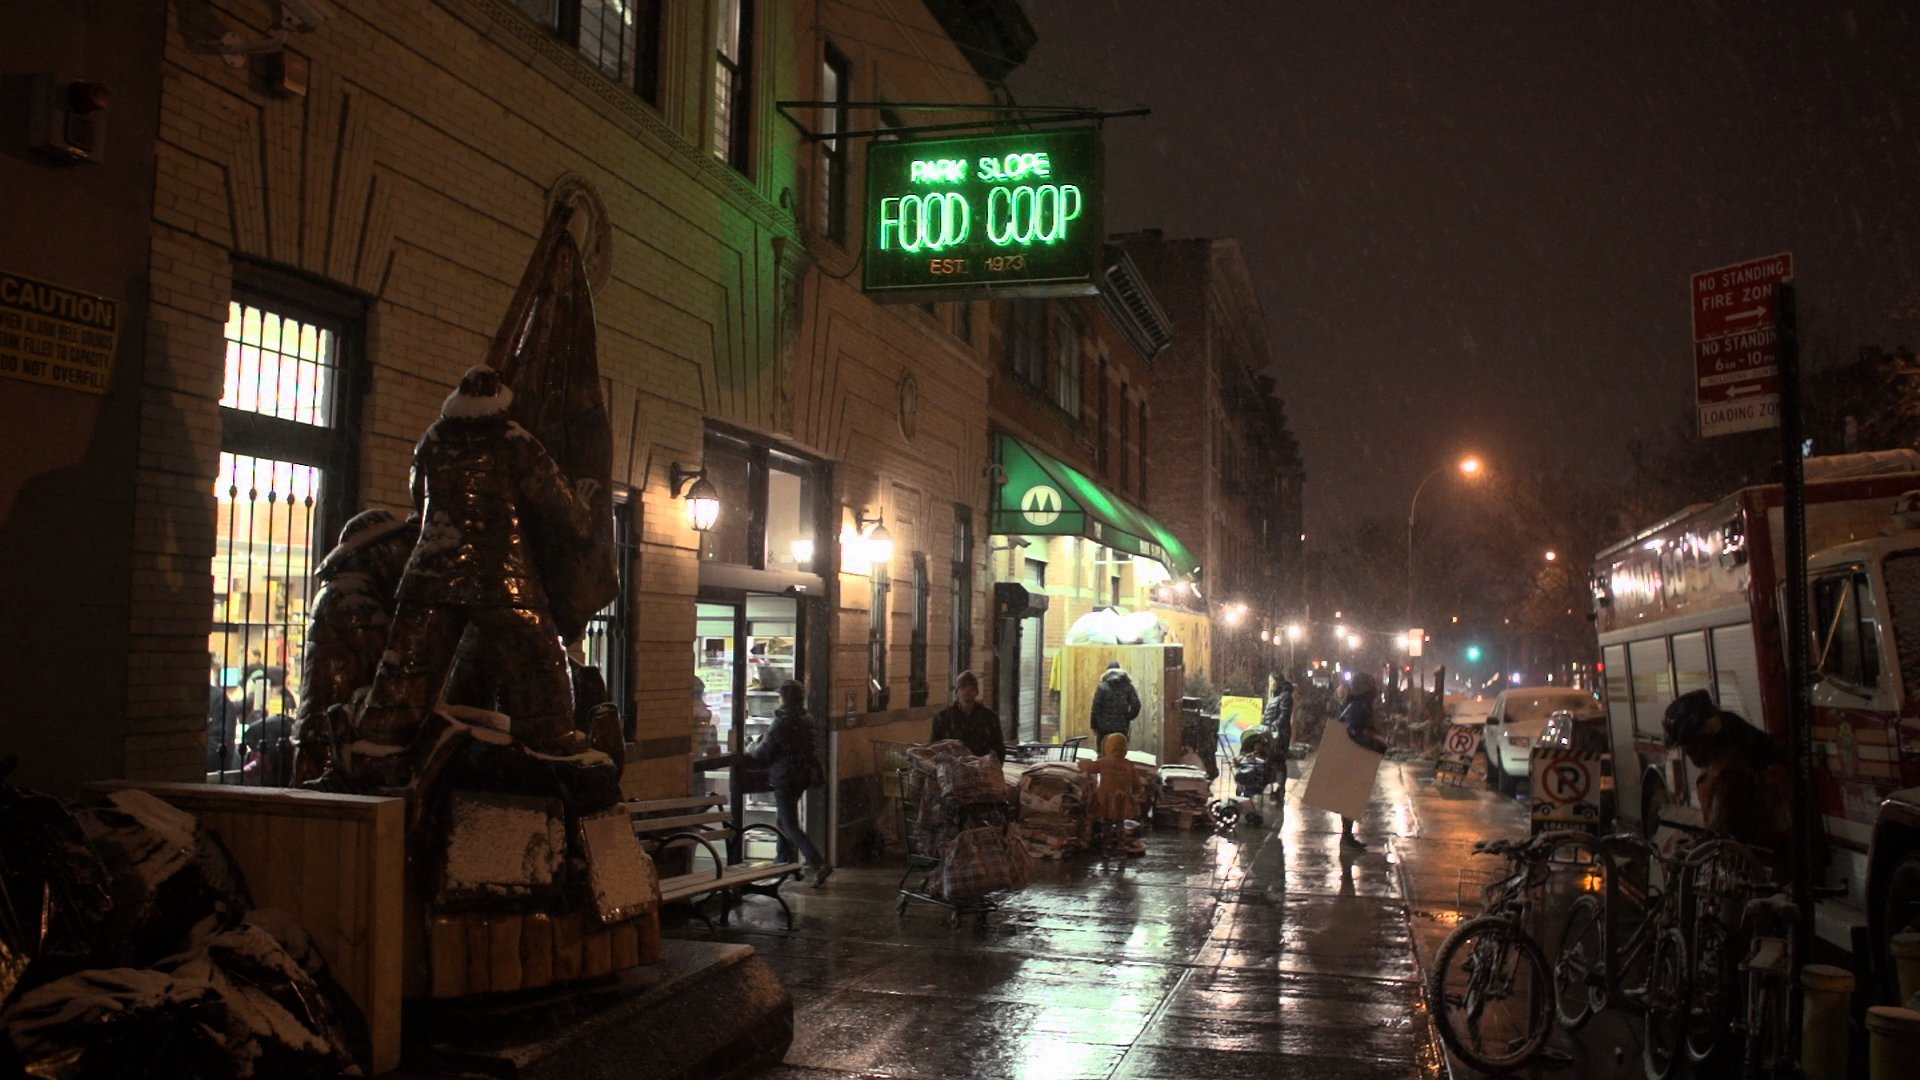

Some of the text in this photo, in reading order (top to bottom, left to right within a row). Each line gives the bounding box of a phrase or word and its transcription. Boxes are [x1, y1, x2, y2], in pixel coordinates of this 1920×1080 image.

[911, 152, 1050, 183] PARK SLOPE
[880, 185, 1081, 252] FOOD COOP
[984, 254, 1025, 273] 1973
[1699, 261, 1784, 294] NO STANDING
[0, 278, 113, 327] CAUTION
[1702, 283, 1773, 312] FIRE ZON
[1702, 331, 1777, 358] NO STANDIN
[0, 354, 107, 389] DO NOT OVERFILL
[1704, 404, 1754, 425] LOADING
